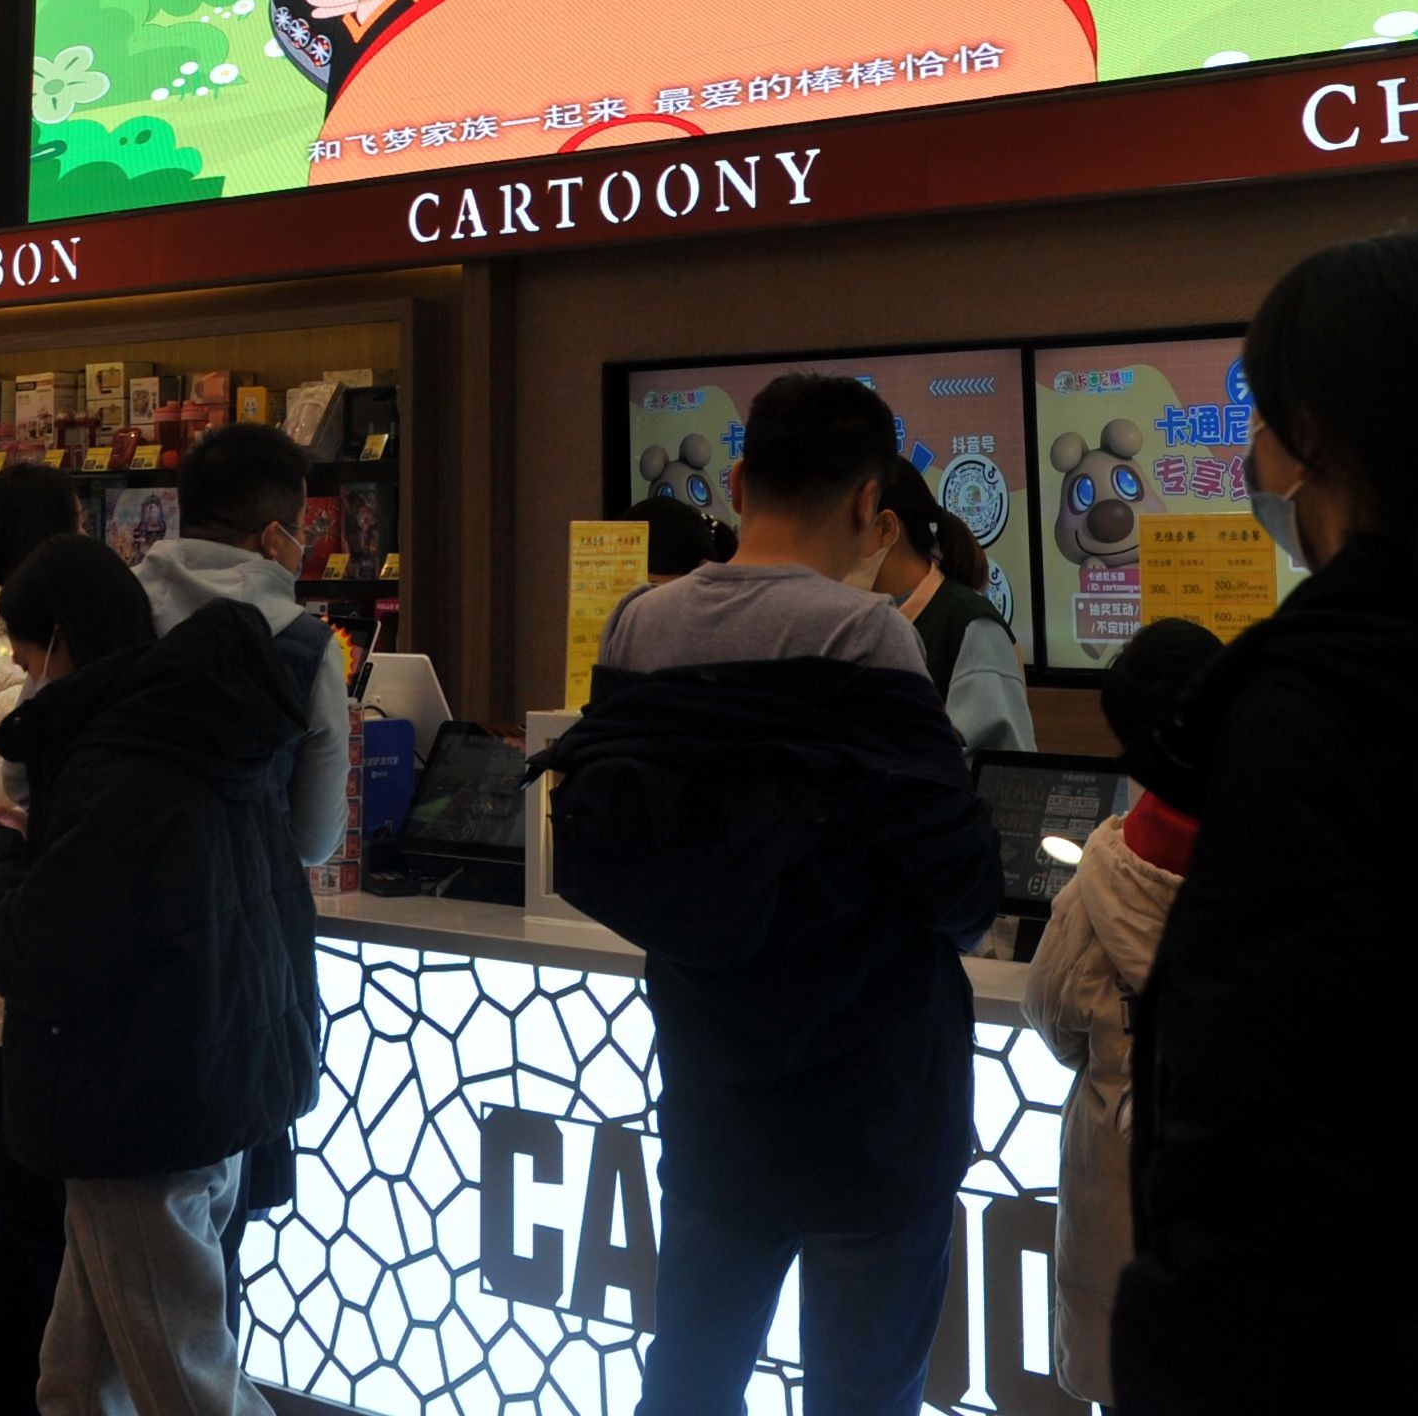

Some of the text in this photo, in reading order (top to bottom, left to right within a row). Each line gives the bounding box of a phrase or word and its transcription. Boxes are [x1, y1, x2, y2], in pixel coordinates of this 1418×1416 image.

[307, 41, 1006, 164] 和飞梦家族一起来 最爱的棒棒恰恰
[407, 148, 822, 244] CARTOONY
[951, 436, 995, 454] 抖音号
